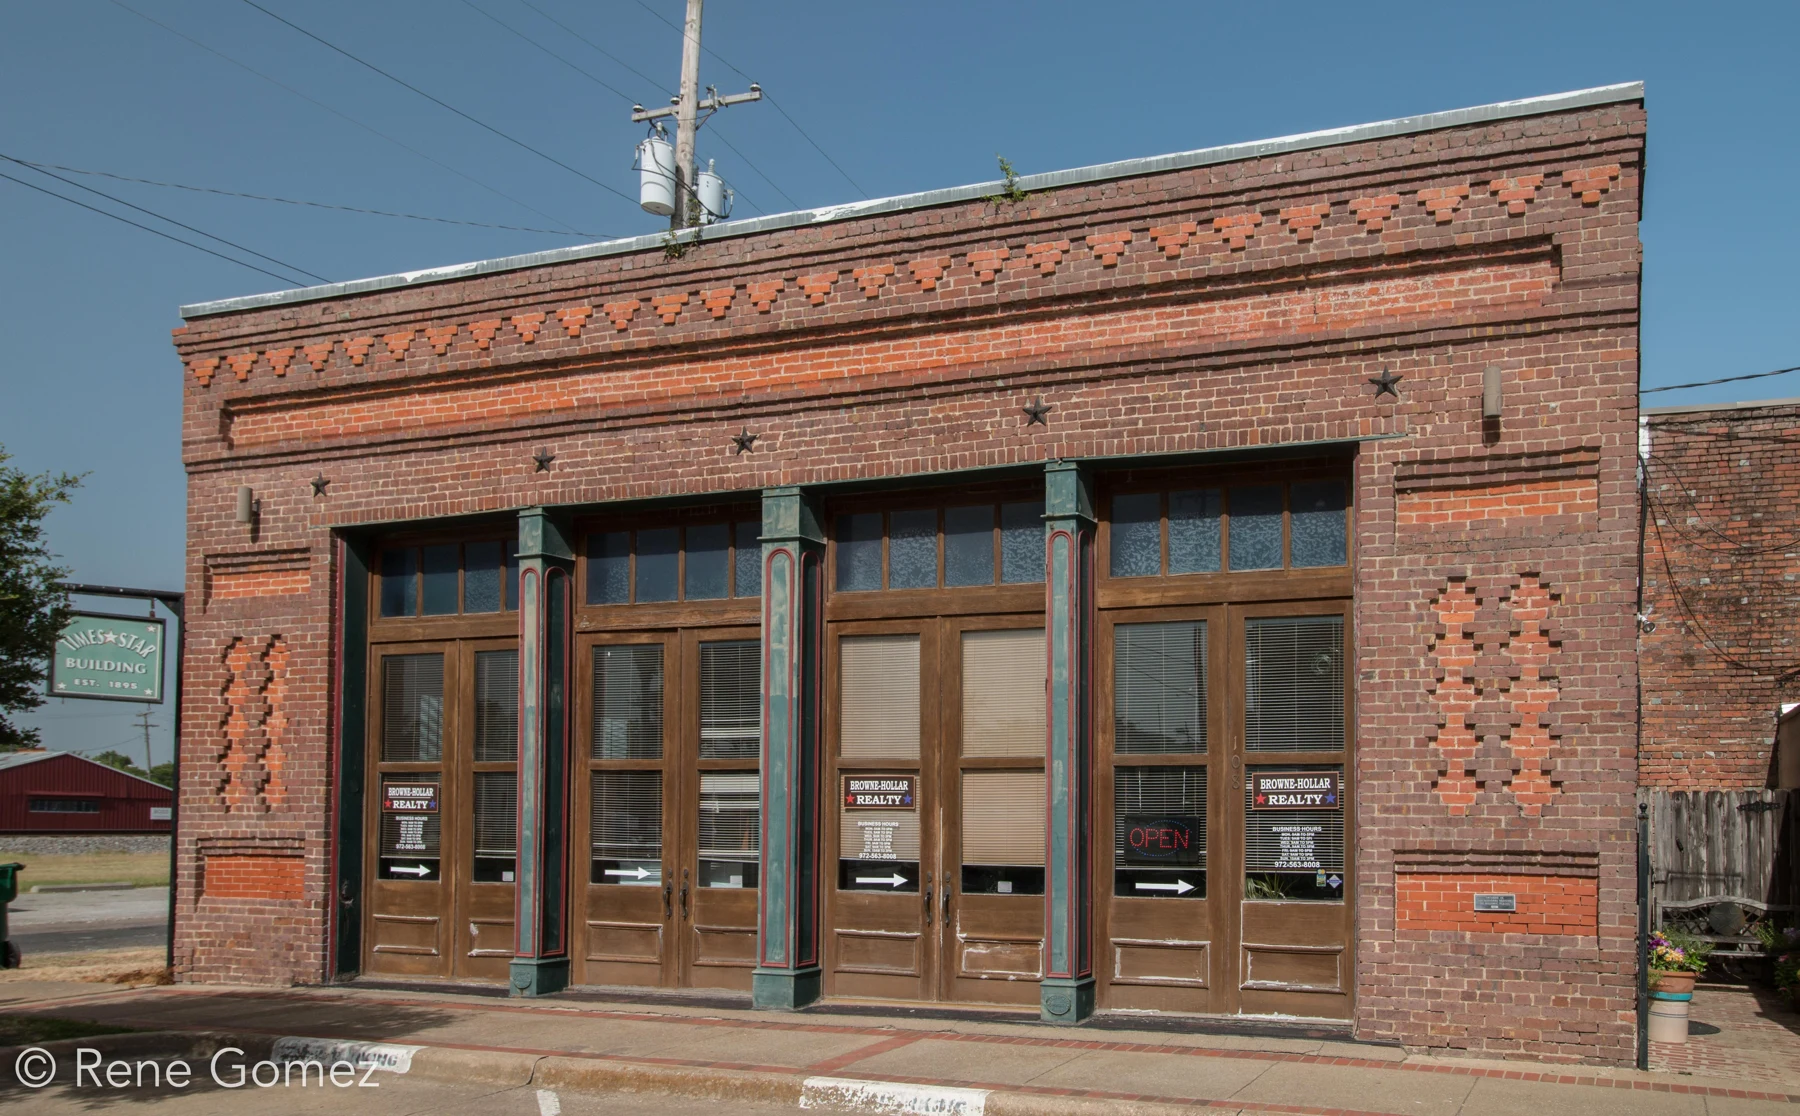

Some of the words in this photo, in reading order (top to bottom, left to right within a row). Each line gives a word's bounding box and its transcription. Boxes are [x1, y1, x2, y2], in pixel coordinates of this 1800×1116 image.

[60, 629, 105, 651] TIMES
[118, 632, 156, 658] STAR
[66, 658, 147, 674] BUILDING
[74, 679, 100, 687] EST.
[110, 681, 138, 690] 1895
[850, 780, 908, 790] BROWNE-HOLLAR
[1260, 778, 1331, 789] BROWNE-HOLLAR
[388, 788, 434, 796] BROWNE-HOLLAR
[393, 800, 428, 809] REALTY
[857, 795, 902, 805] REALTY
[1268, 794, 1323, 805] REALTY
[1129, 827, 1189, 848] OPEN
